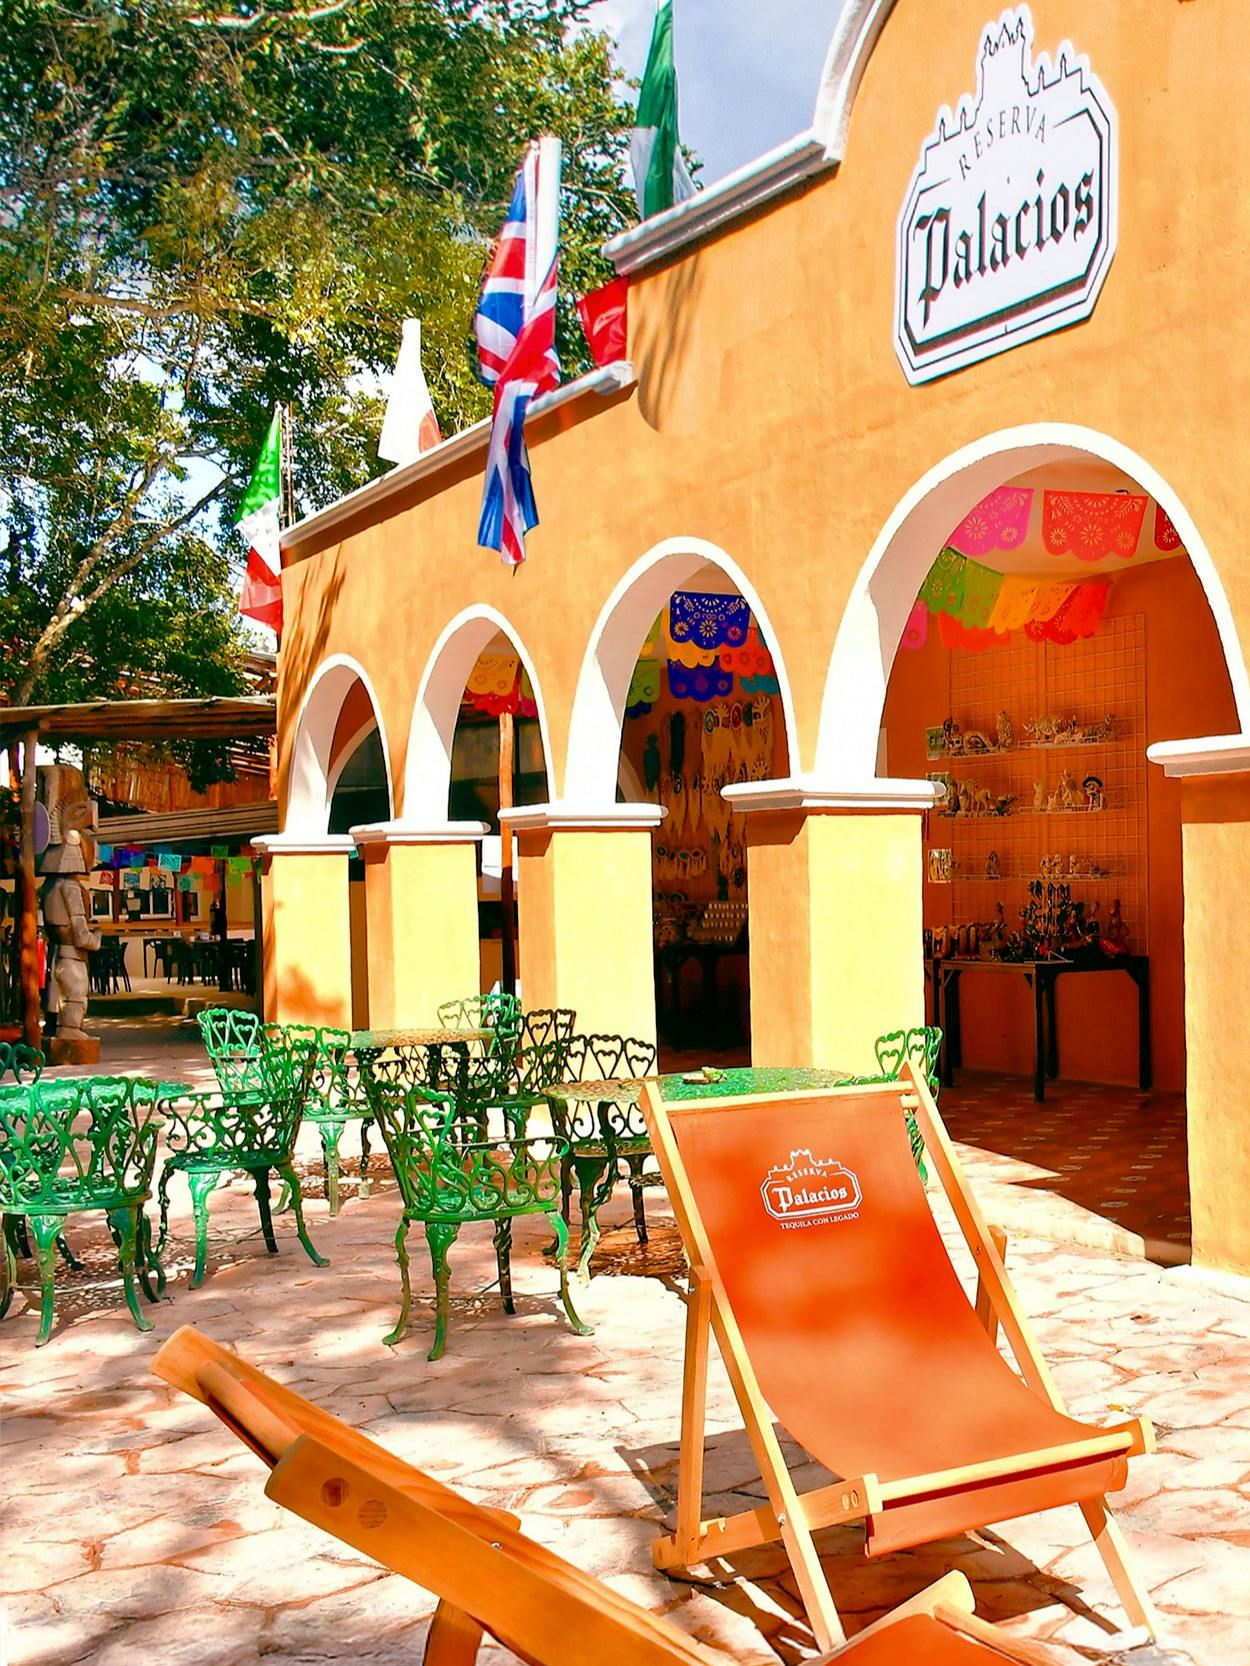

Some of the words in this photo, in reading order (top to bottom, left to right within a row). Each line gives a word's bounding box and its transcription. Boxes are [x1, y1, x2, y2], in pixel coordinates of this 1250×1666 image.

[958, 105, 1047, 180] RESERVA
[913, 167, 1094, 330] Palacios
[786, 1168, 828, 1183] RESERVA
[771, 1186, 848, 1213] Palacios
[780, 1219, 812, 1230] TEQUILA
[812, 1217, 830, 1226] CON
[830, 1212, 859, 1223] LEGADO
